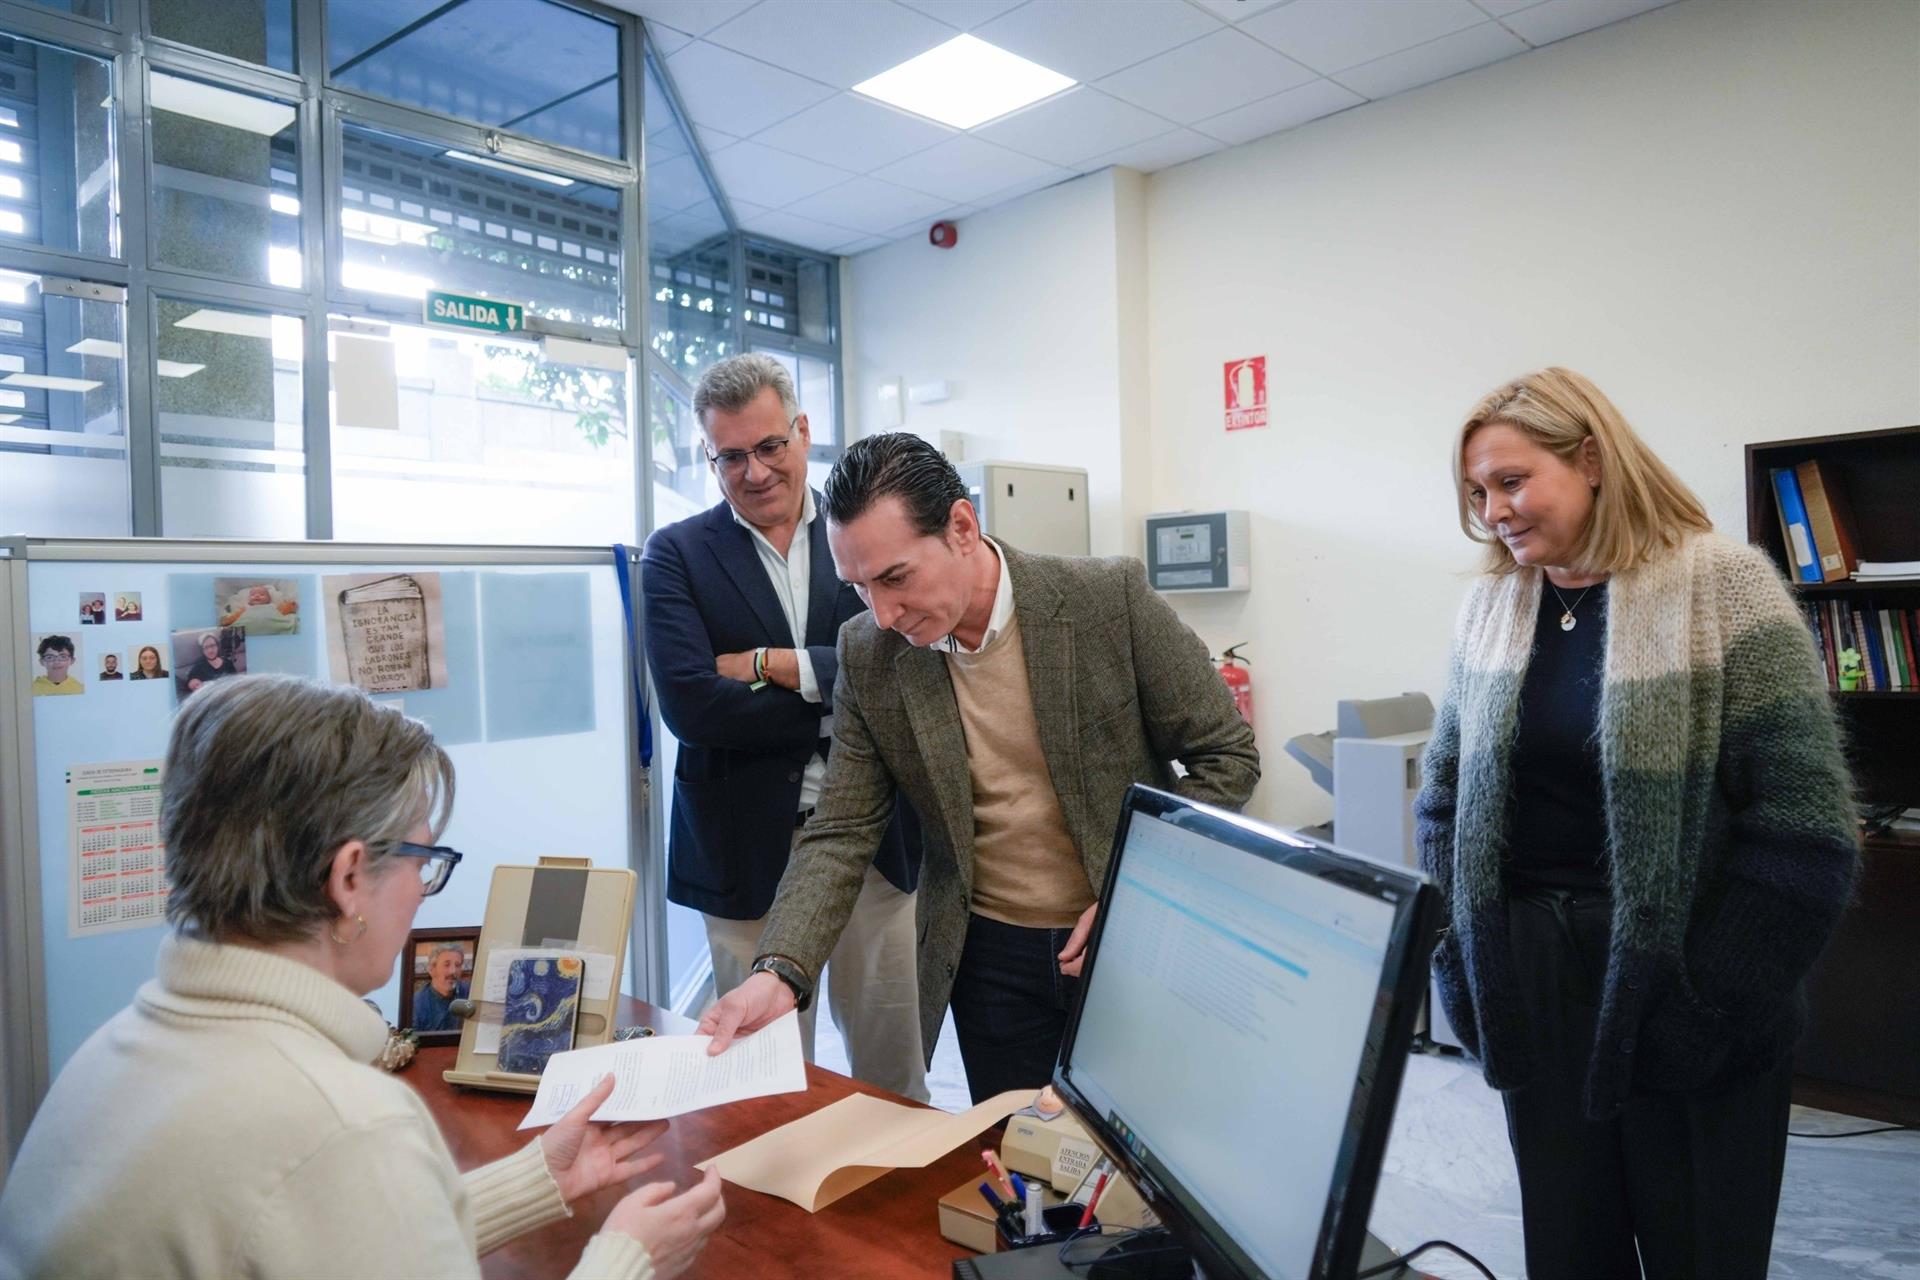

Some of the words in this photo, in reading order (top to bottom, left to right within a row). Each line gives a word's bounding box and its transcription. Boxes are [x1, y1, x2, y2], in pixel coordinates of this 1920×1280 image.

[434, 299, 500, 325] SALIDA
[377, 605, 389, 616] LA
[352, 613, 417, 628] IGNORANCIA
[367, 627, 378, 635] ES
[368, 645, 384, 654] QUE
[358, 667, 374, 675] NO
[377, 662, 412, 674] ROBAN
[1059, 1155, 1087, 1168] ENTRADA
[1060, 1164, 1081, 1176] SALIDA
